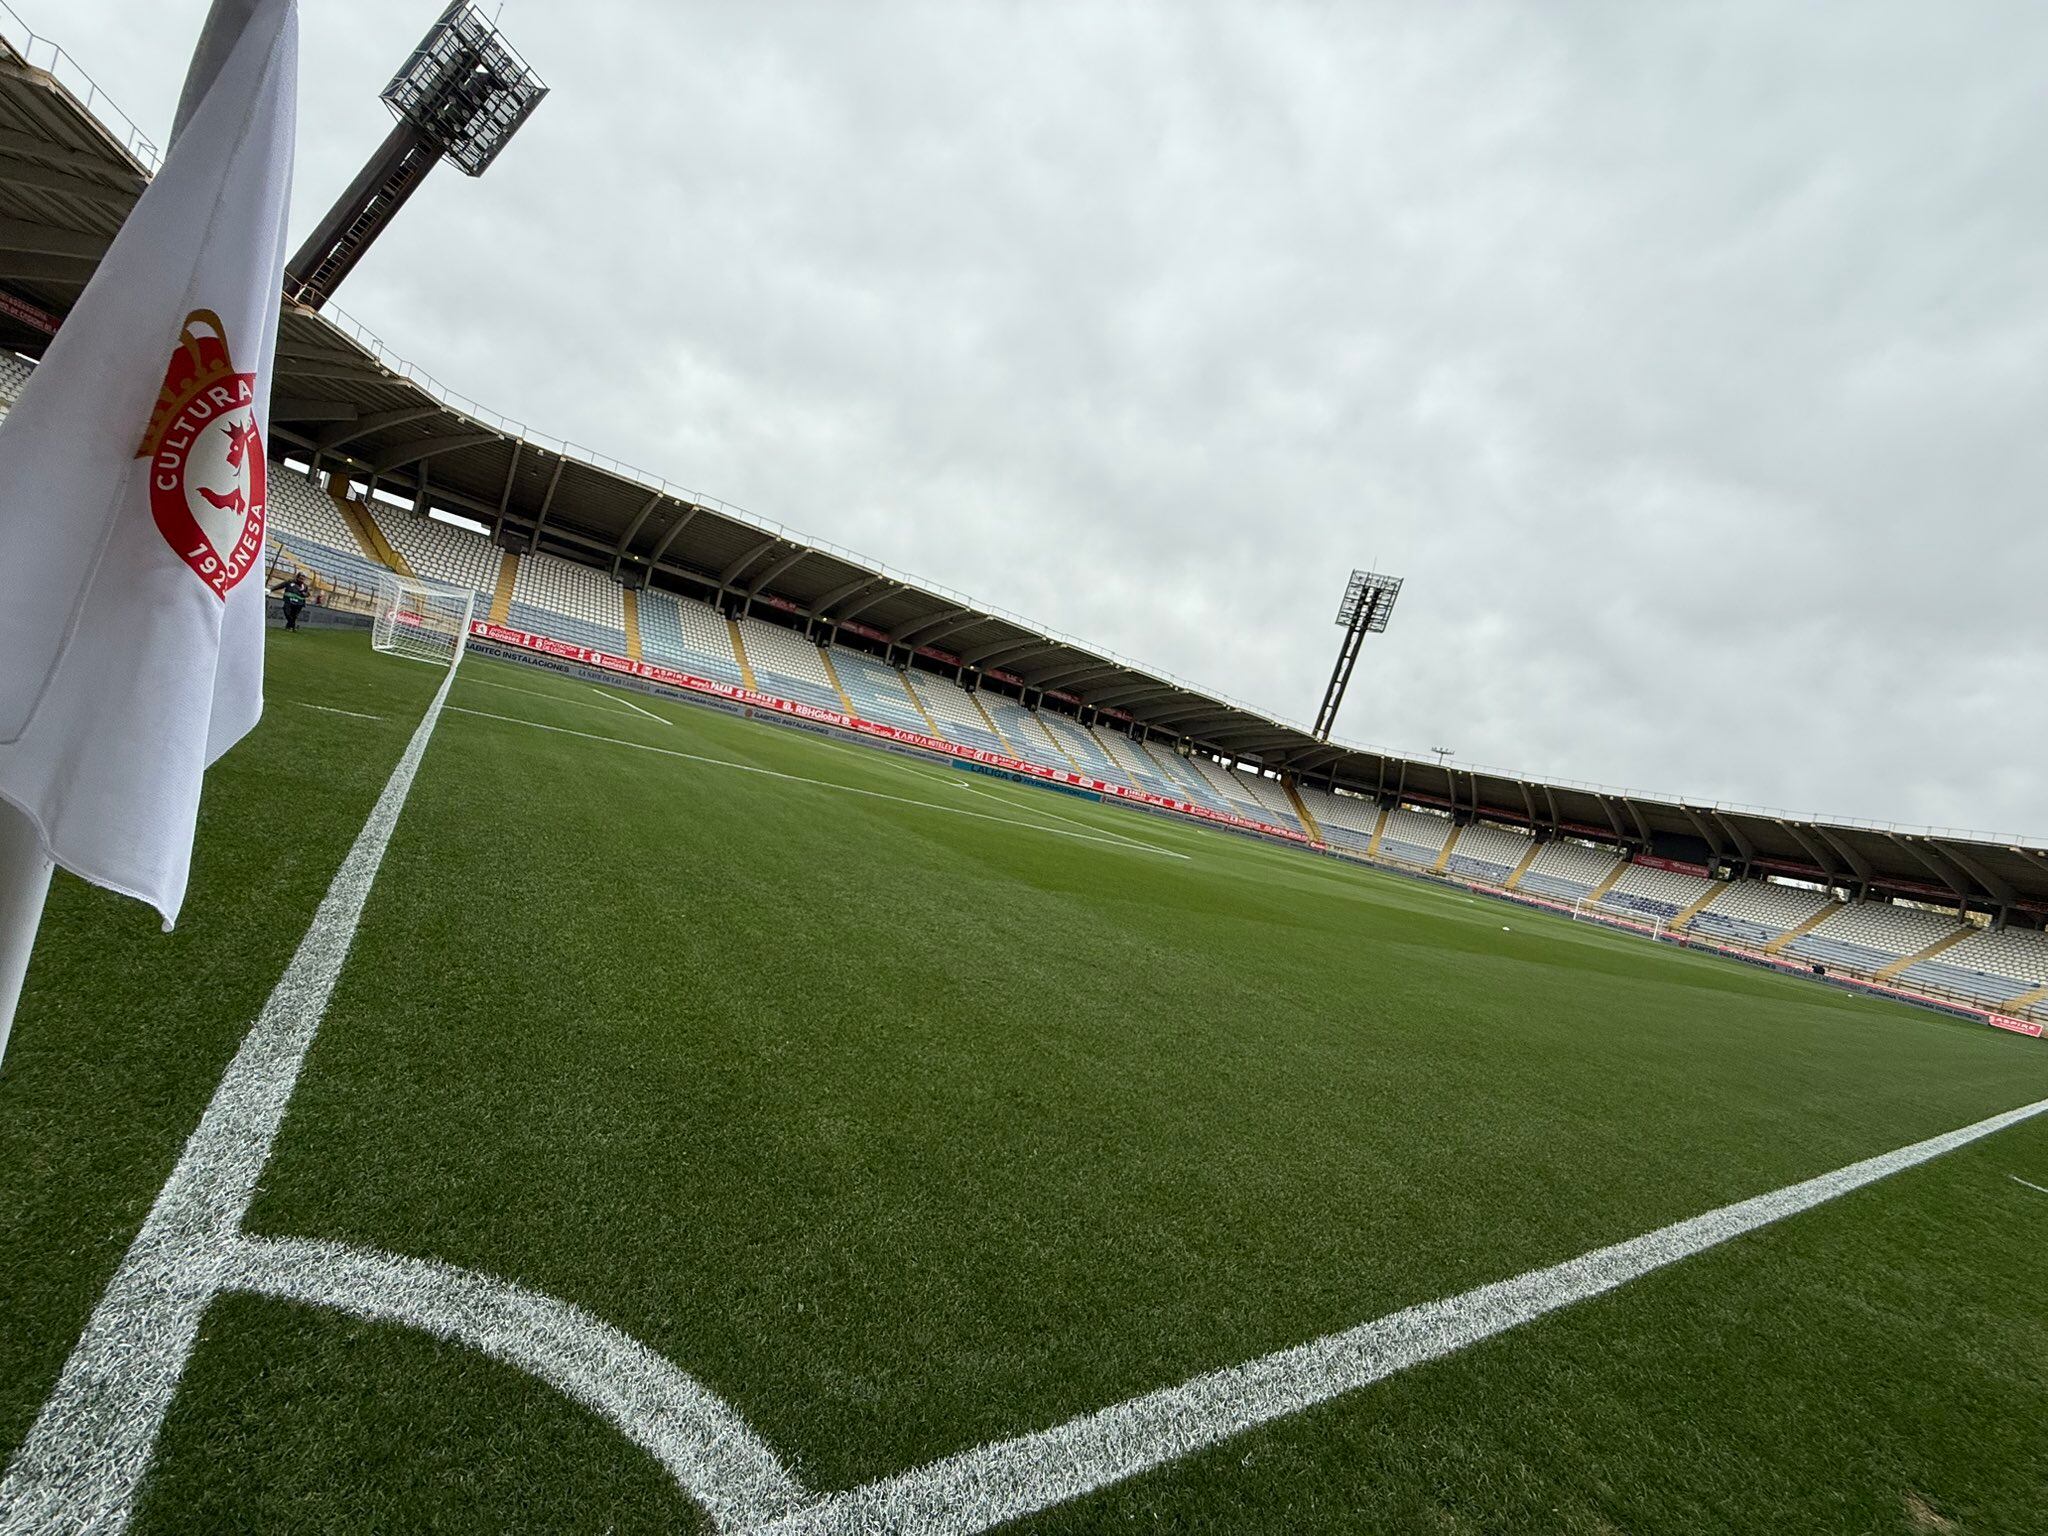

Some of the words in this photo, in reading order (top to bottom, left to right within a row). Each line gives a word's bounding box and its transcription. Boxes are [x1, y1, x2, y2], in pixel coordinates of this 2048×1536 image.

[226, 503, 263, 580] ONESA
[186, 542, 228, 595] 192
[502, 651, 569, 673] INSTALACIONES
[653, 667, 688, 681] ASPIRE
[970, 765, 1008, 779] LALIGA
